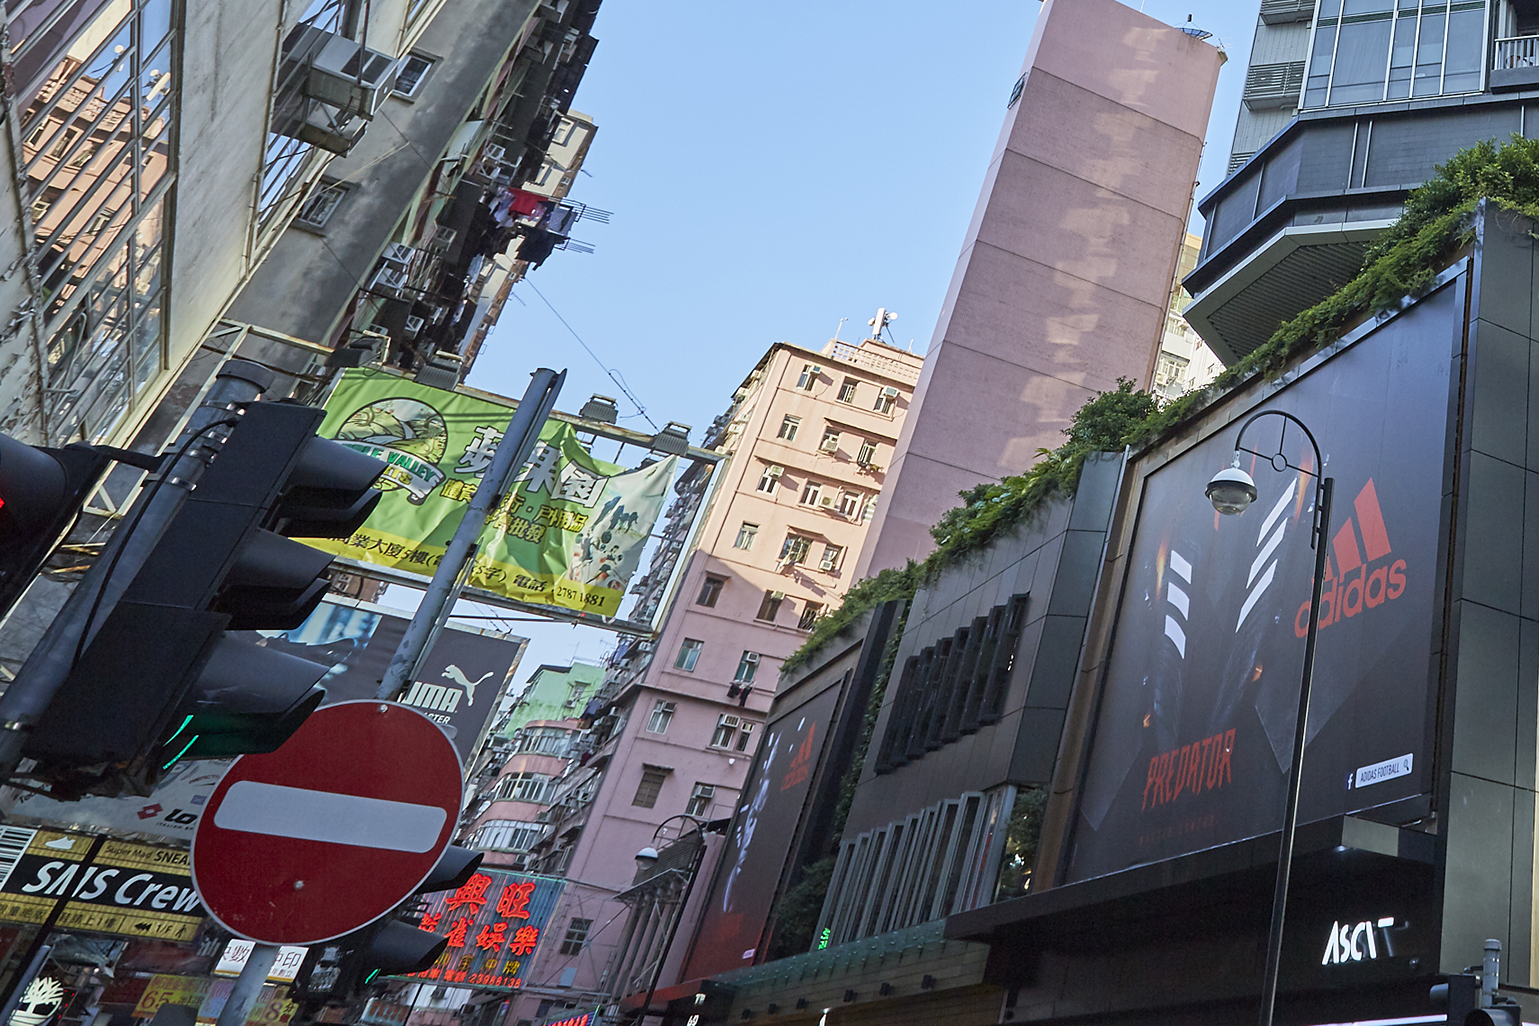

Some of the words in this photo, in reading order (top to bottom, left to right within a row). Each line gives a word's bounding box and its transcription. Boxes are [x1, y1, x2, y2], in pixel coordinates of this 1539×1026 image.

[388, 451, 436, 482] VALLEY
[556, 586, 577, 601] 2787
[579, 592, 606, 608] 1881
[1294, 559, 1407, 638] adidas
[397, 681, 463, 713] UMA
[1141, 728, 1236, 813] PREDATOR
[1360, 768, 1377, 782] ADIDAS
[1377, 762, 1400, 778] FOOTBALL
[105, 845, 132, 859] Super
[154, 851, 191, 866] SNEA
[114, 874, 200, 913] Crew
[446, 873, 535, 919] 興旺
[156, 924, 173, 934] 1/F
